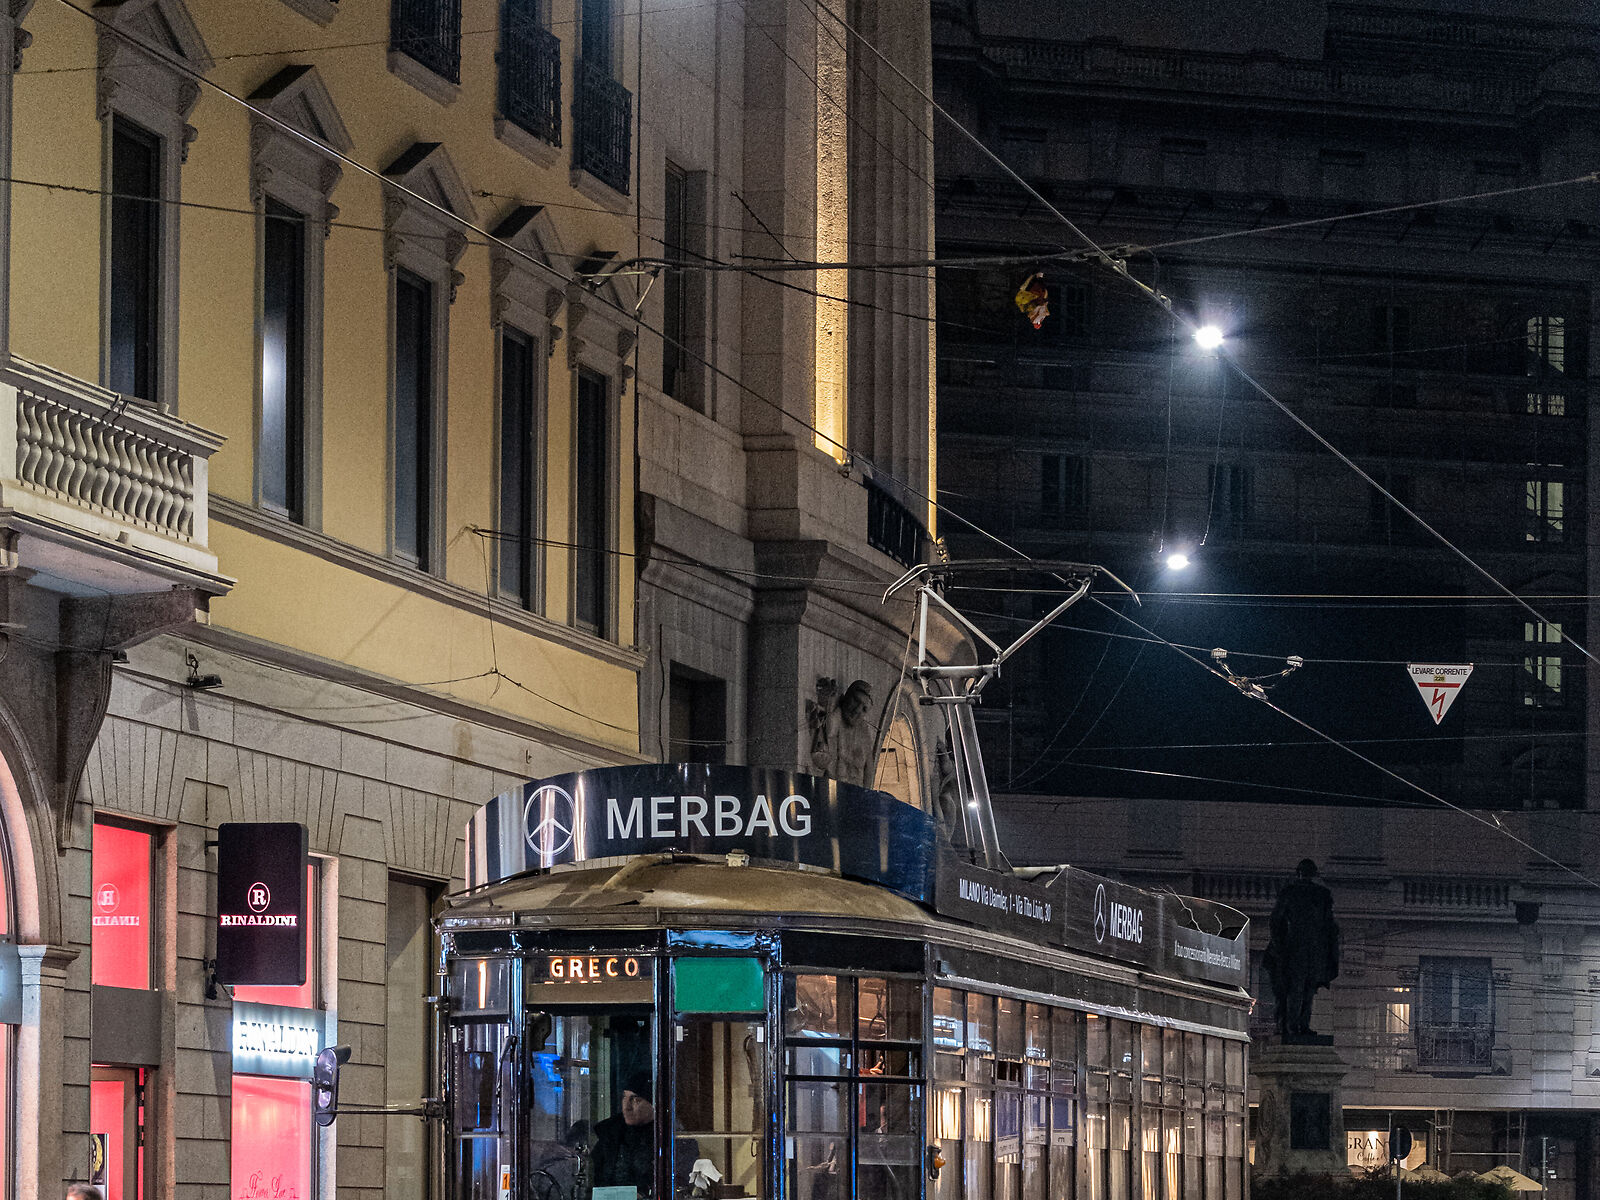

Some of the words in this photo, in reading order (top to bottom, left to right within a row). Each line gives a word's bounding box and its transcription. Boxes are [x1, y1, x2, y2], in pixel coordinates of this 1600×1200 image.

[1412, 667, 1434, 675] LEVARE
[1435, 668, 1468, 676] CORRENTE
[607, 795, 812, 840] MERBAG
[252, 889, 267, 906] R
[960, 878, 980, 903] MILANO
[980, 884, 989, 906] Via
[220, 914, 297, 926] RINALDINI
[1110, 901, 1143, 944] MERBAG
[550, 957, 640, 978] GRECO
[477, 960, 488, 1010] 1
